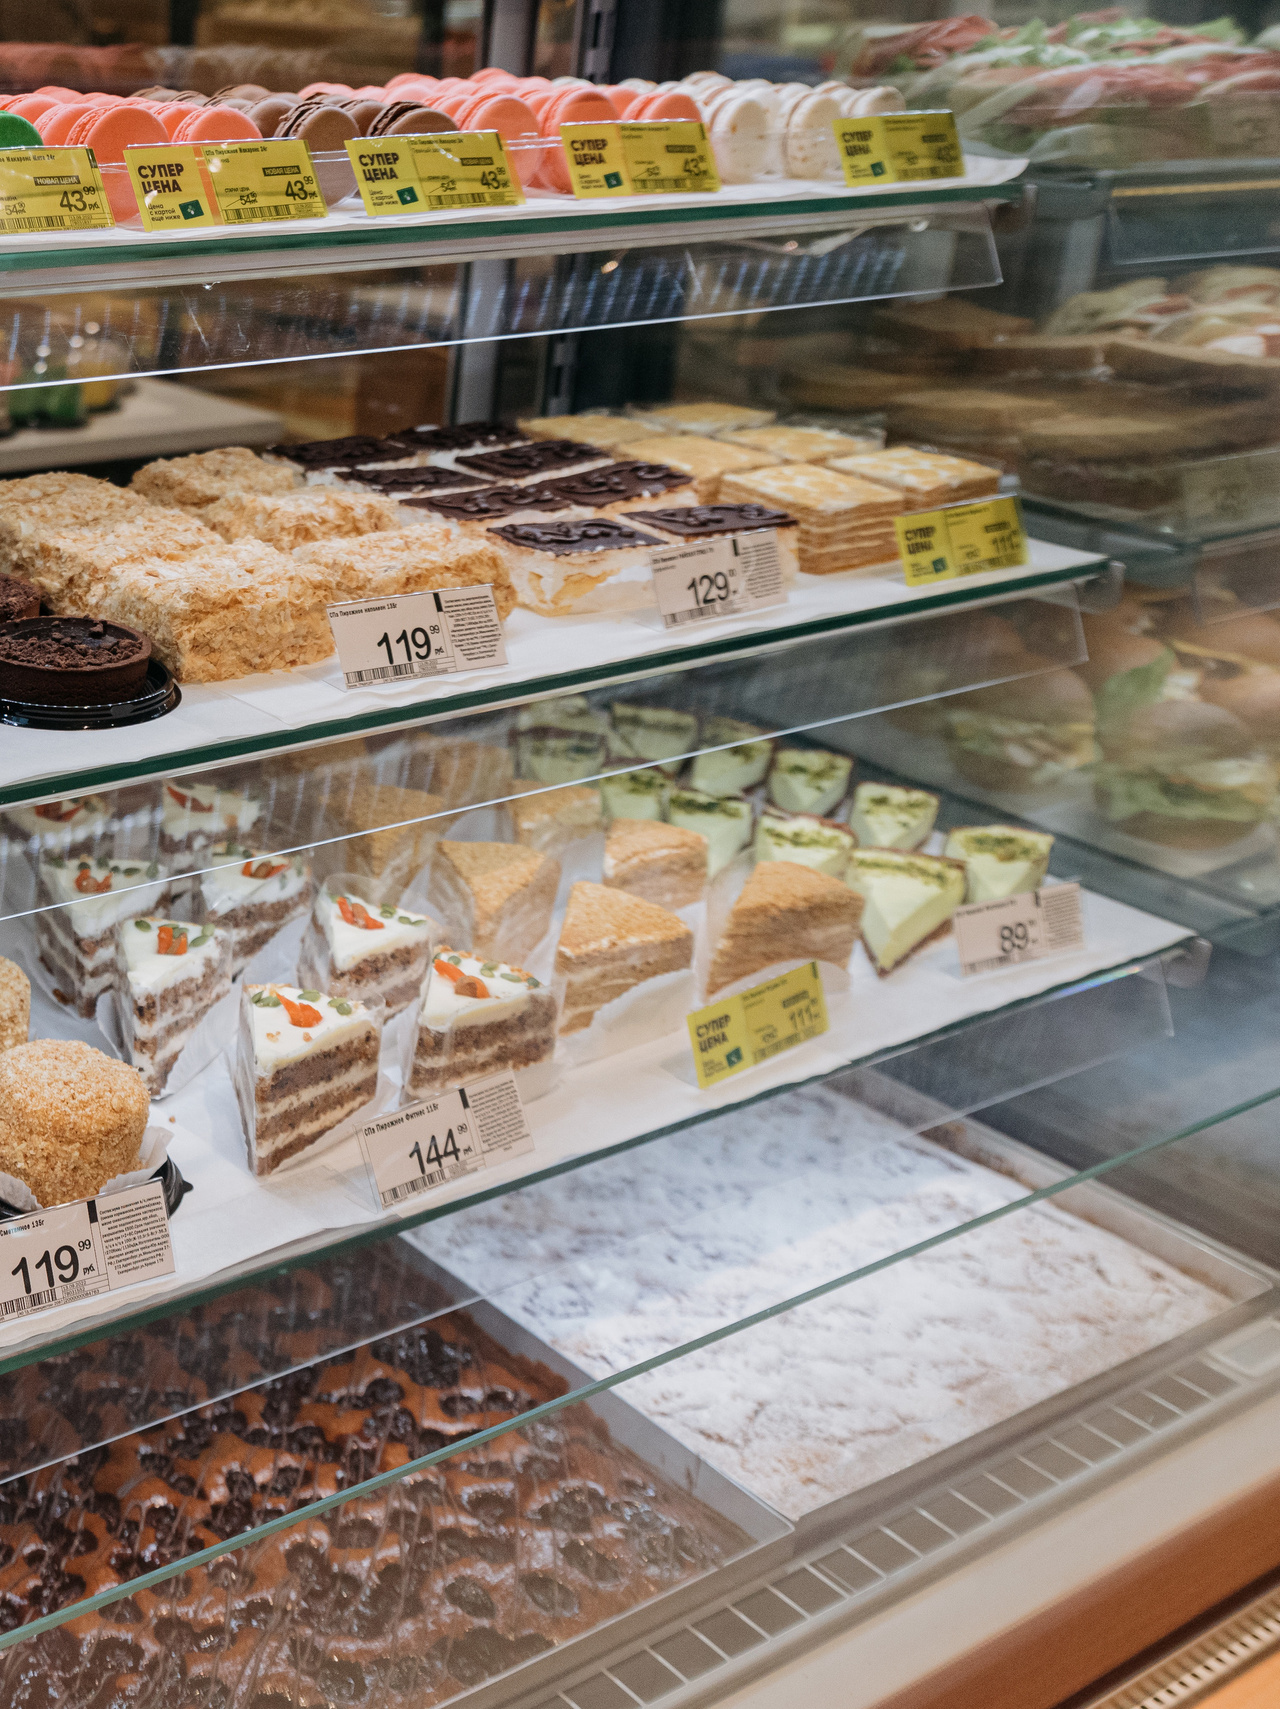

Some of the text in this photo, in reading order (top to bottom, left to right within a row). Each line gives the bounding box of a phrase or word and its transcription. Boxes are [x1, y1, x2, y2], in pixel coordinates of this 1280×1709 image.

[571, 139, 608, 151] СУПЕР
[358, 152, 400, 166] СУПЕР
[574, 153, 606, 167] ЦЕНА
[137, 163, 184, 178] СУПЕР
[363, 167, 398, 183] ЦЕНА
[479, 170, 500, 190] 43
[36, 177, 59, 185] НОВАЯ
[142, 179, 181, 194] ЦЕНА
[283, 175, 313, 201] 43 99
[57, 185, 96, 212] 43 99
[154, 208, 175, 216] картой
[687, 572, 730, 606] 129
[340, 609, 363, 617] Пирожное
[377, 625, 440, 664] 119 99
[1001, 922, 1029, 953] 89
[696, 1014, 731, 1038] СУПЕР
[699, 1032, 728, 1054] ЦЕНА
[376, 1117, 404, 1132] Пирожное
[406, 1109, 425, 1121] Фитнес
[409, 1123, 468, 1174] 144 99
[0, 1224, 30, 1236] Сметанное
[32, 1219, 44, 1228] 135г
[11, 1239, 91, 1294] 119 99
